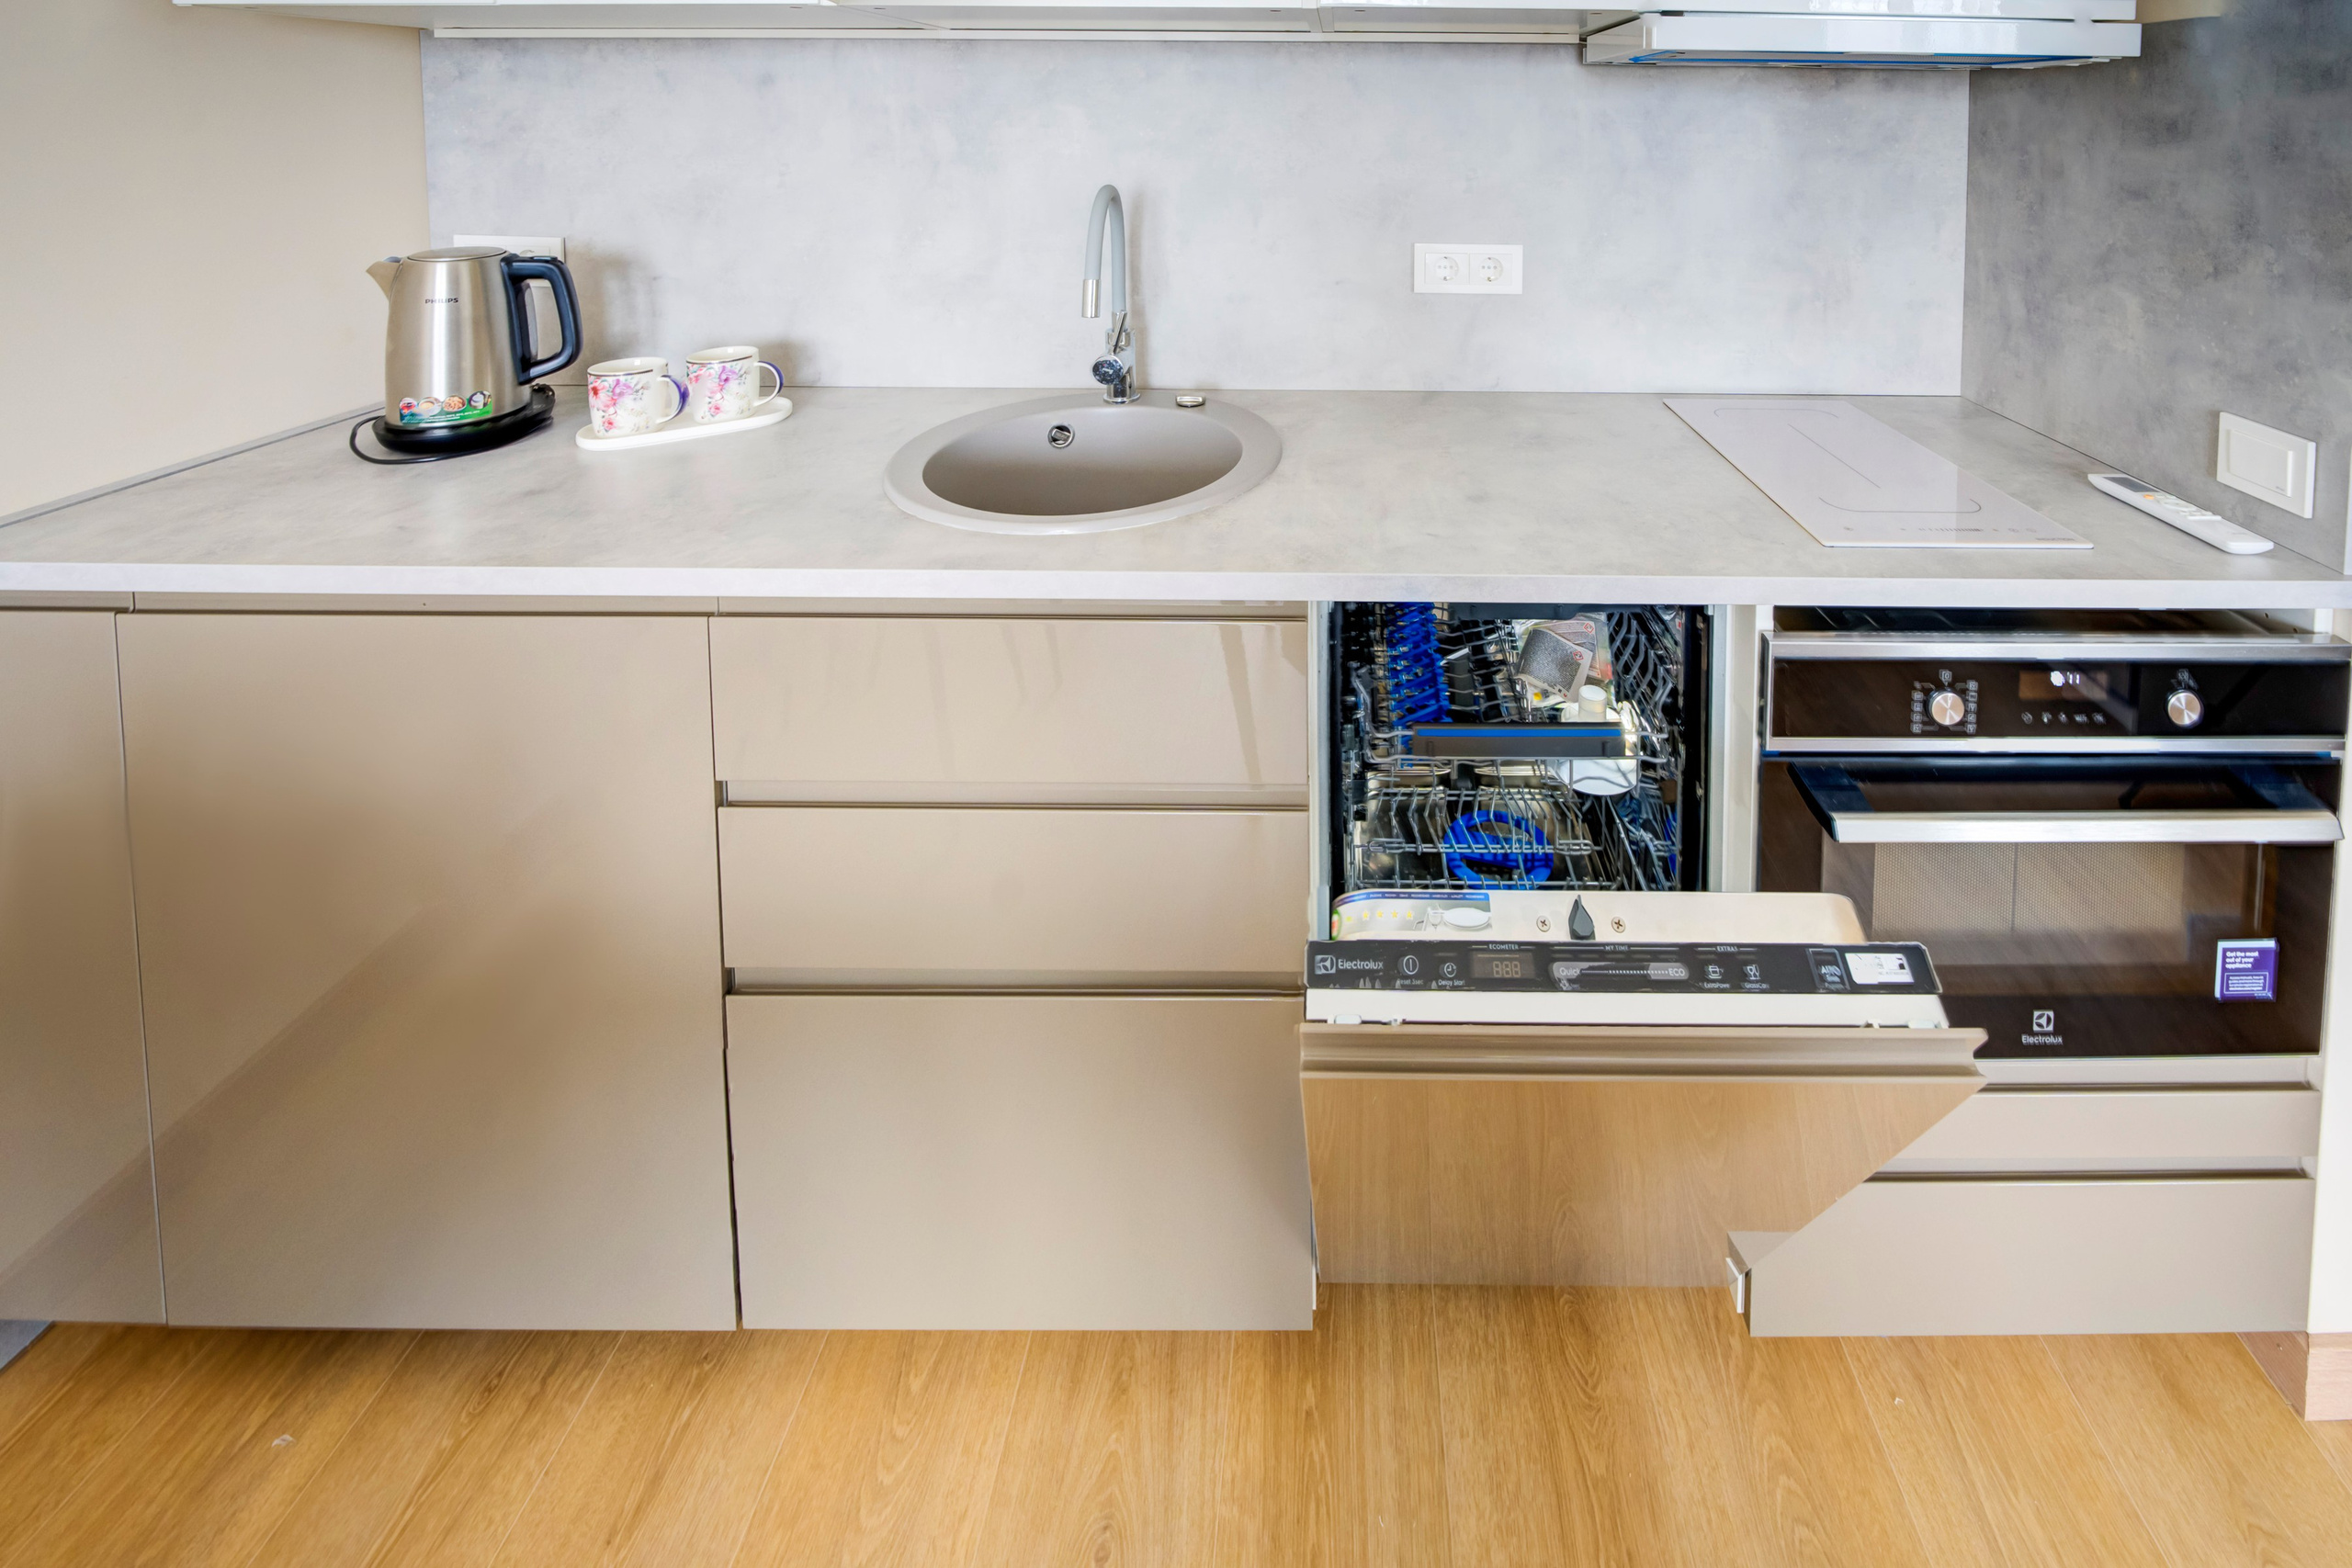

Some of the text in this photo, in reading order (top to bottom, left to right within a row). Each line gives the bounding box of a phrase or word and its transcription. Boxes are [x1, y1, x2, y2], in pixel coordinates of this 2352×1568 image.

[1338, 958, 1384, 970] Electrolux
[1559, 967, 1580, 976] Quick
[1668, 968, 1686, 976] ECO
[2021, 1034, 2064, 1045] Electrolux
